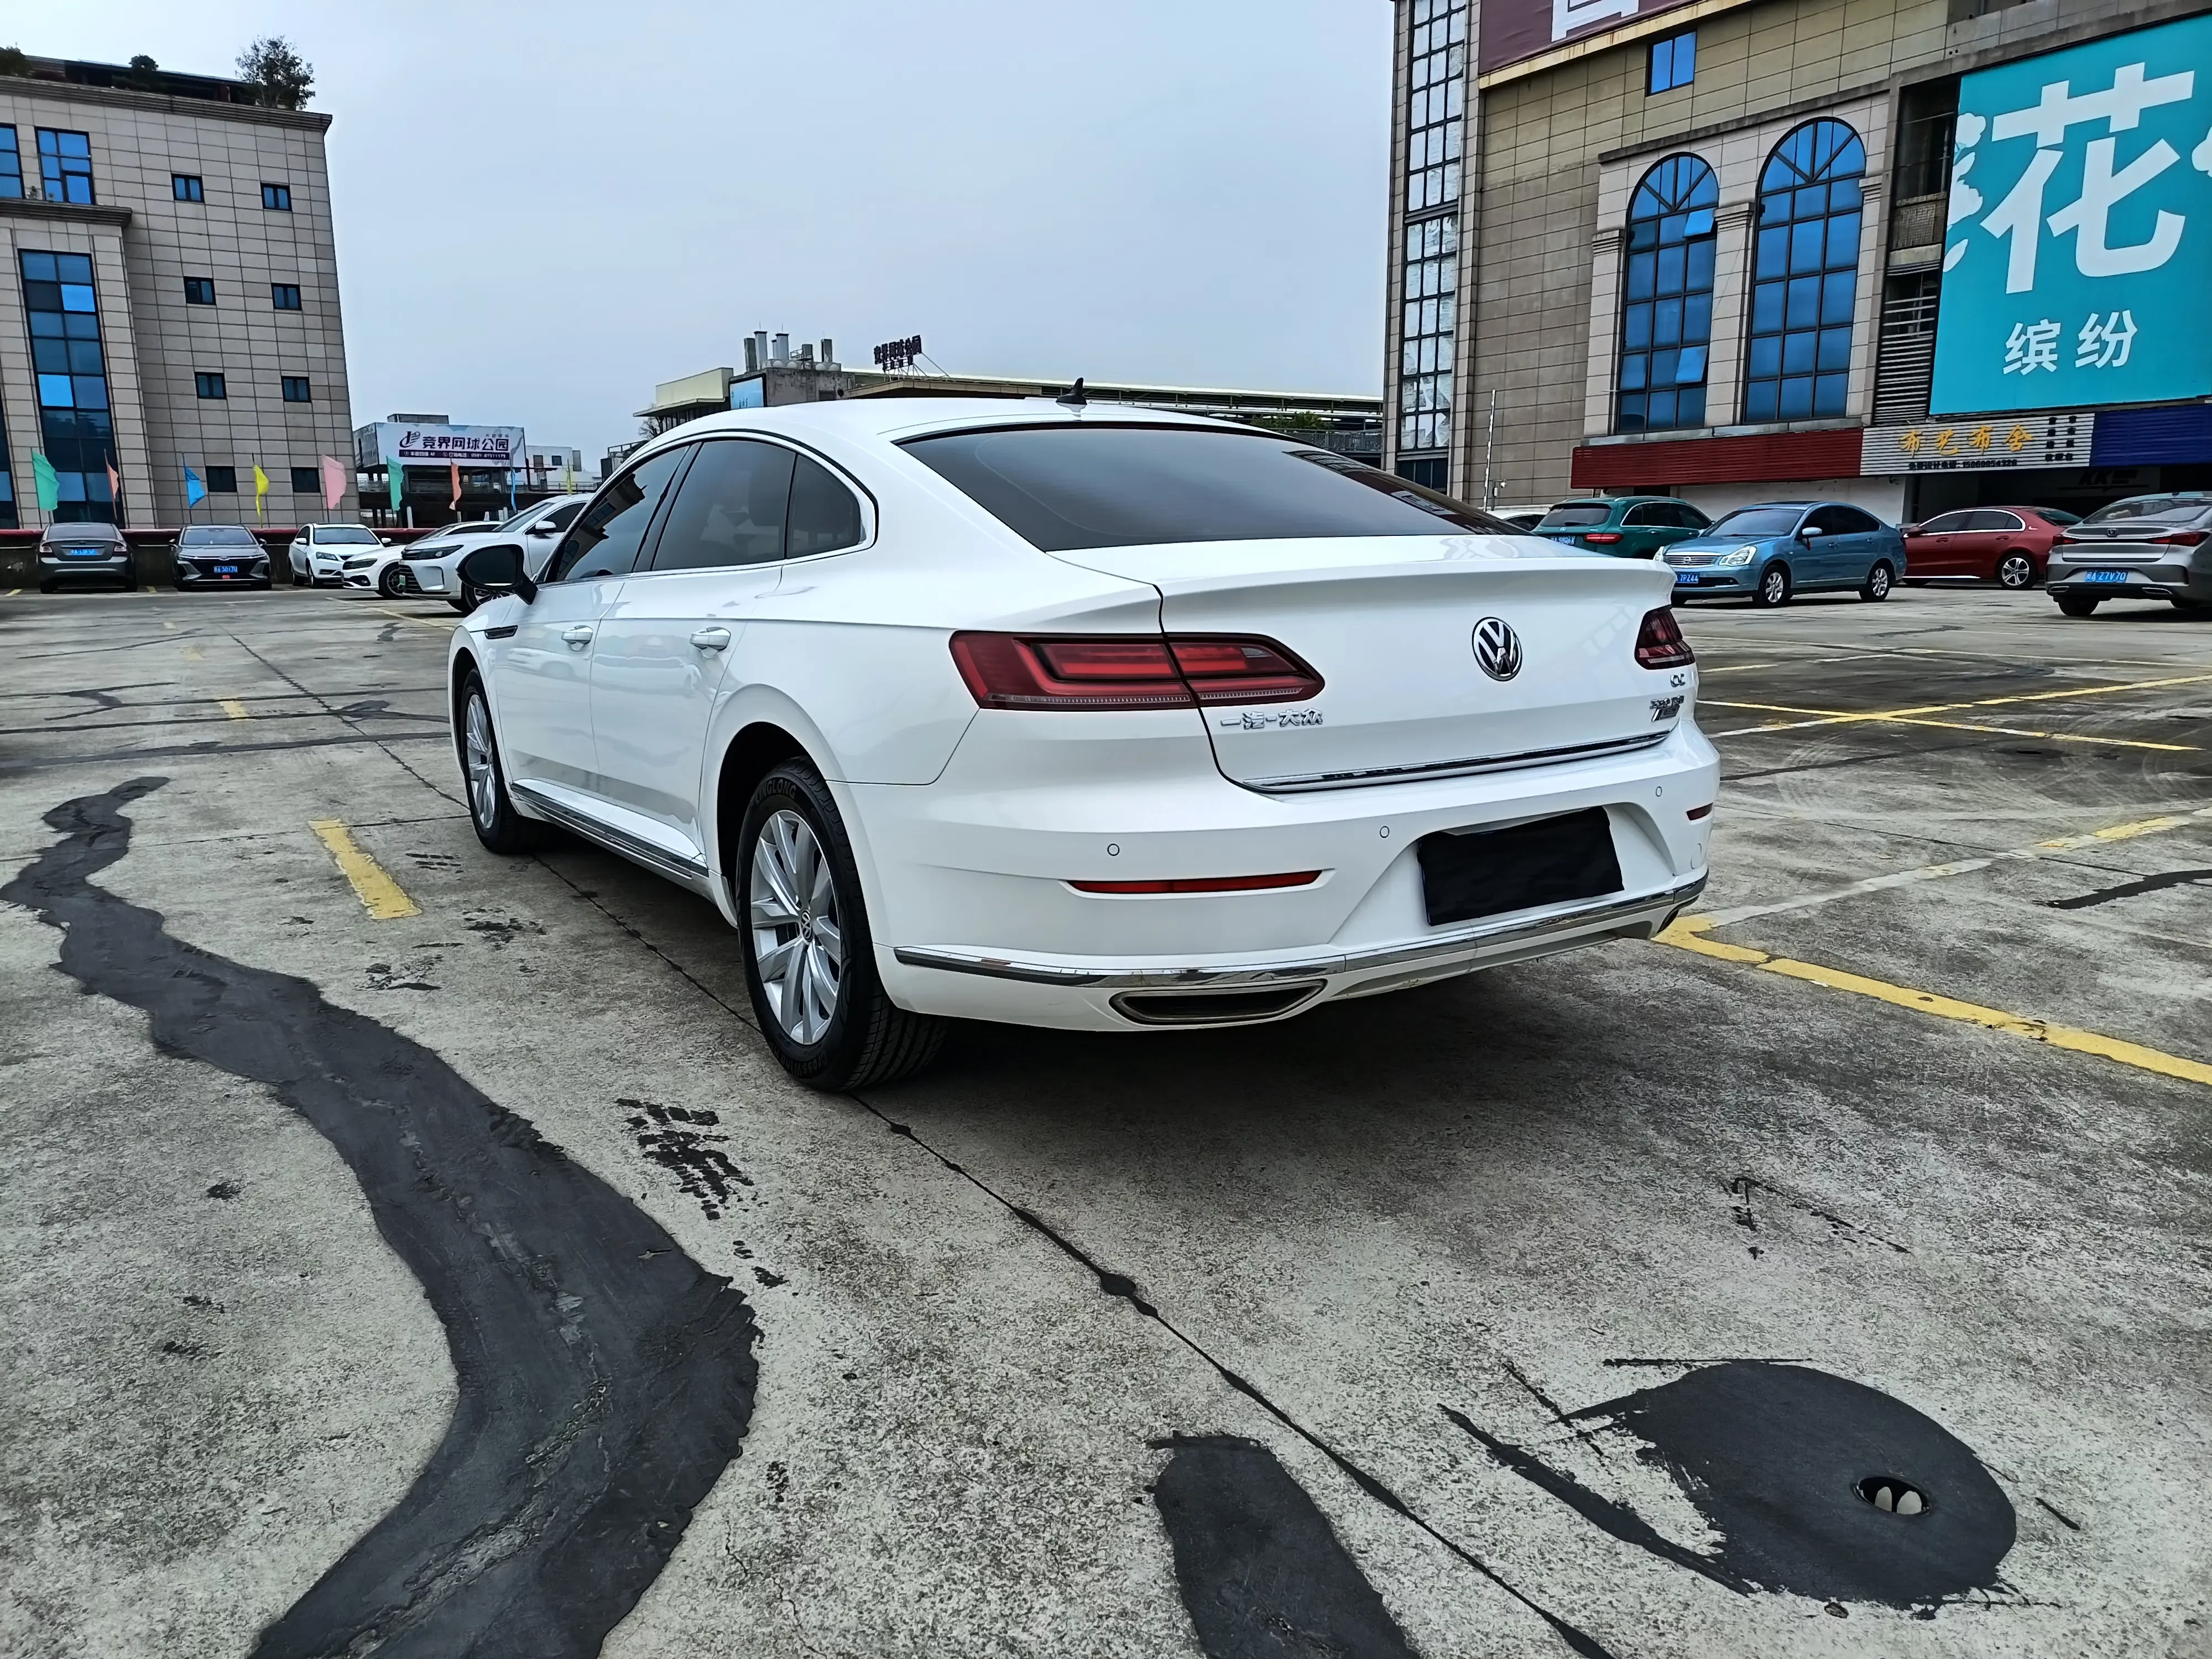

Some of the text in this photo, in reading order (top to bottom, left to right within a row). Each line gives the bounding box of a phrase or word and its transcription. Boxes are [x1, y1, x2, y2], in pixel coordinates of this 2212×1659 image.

[1980, 62, 2195, 294] 花
[2002, 309, 2138, 376] 缤纷
[422, 436, 509, 451] 竞界网球公园
[1220, 707, 1323, 730] 一汽-大众
[755, 778, 797, 806] LINGLONG
